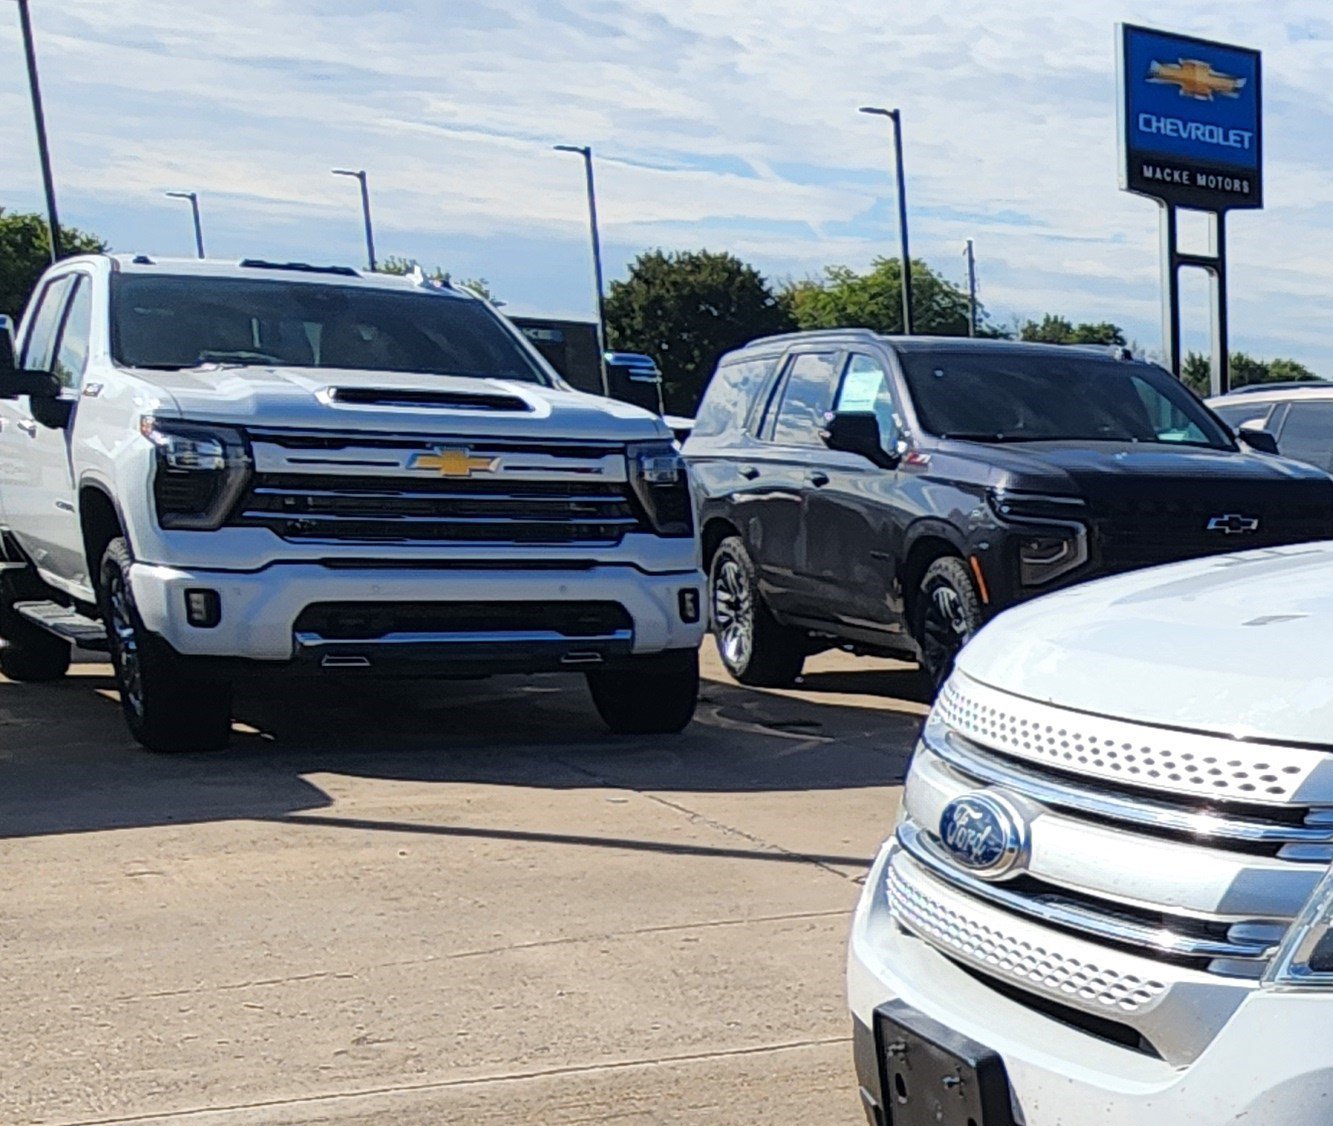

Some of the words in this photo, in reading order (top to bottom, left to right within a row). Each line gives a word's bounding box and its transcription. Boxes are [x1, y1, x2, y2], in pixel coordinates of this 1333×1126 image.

[1138, 113, 1253, 149] CHEVROLET
[1142, 164, 1190, 184] MACKE
[1196, 172, 1250, 193] MOTORS
[947, 803, 992, 860] Ford
